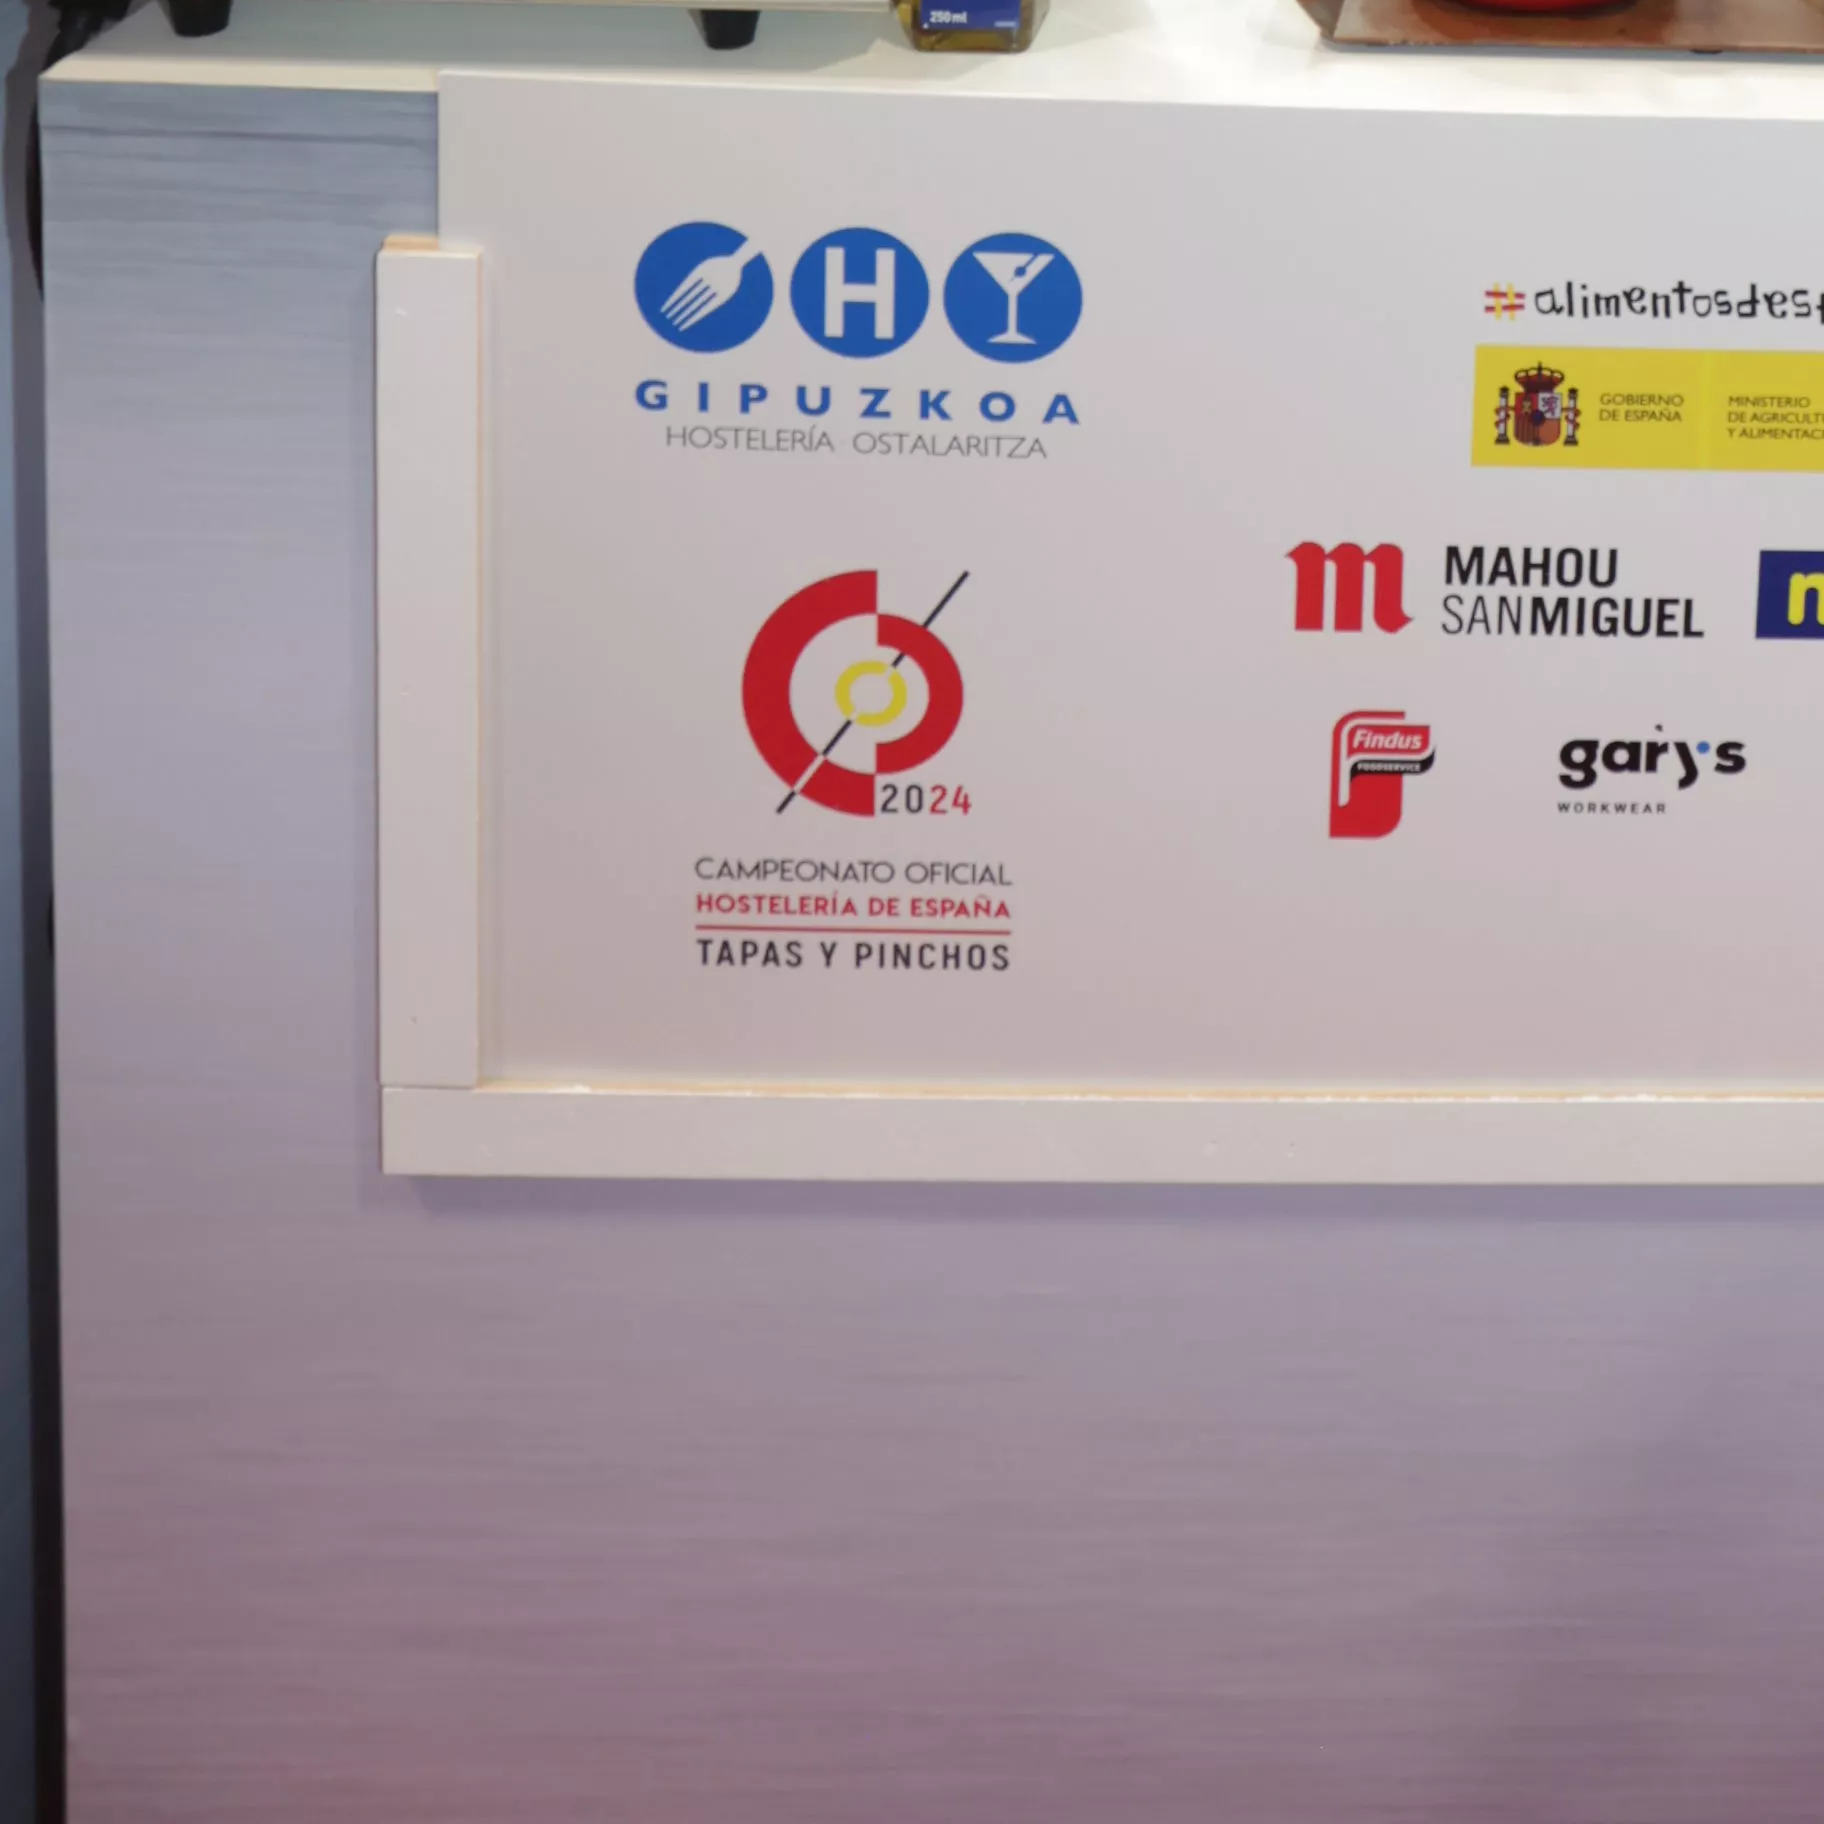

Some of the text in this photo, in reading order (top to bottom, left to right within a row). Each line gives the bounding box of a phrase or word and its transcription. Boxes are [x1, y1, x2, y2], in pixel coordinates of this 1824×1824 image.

[634, 379, 1081, 425] GIPUZKOA
[1599, 392, 1685, 408] GOBIERNO
[1599, 407, 1683, 423] DE ESPAÑA
[1728, 395, 1811, 410] MINISTERIO
[1727, 411, 1747, 424] DE
[665, 424, 1048, 459] HOSTELERÍA OSTALARITZA
[1727, 427, 1737, 440] Y
[1444, 545, 1618, 589] MAHOU
[1440, 594, 1705, 639] SANMIGUEL
[1351, 728, 1423, 751] Findus
[880, 783, 972, 816] 2024
[1557, 801, 1667, 815] WORKWEAR
[694, 856, 1013, 886] CAMPEONATO OFICIAL
[696, 890, 1011, 920] HOSTELERÍA DE ESPAÑA
[696, 938, 1010, 972] TAPAS Y PINCHOS
